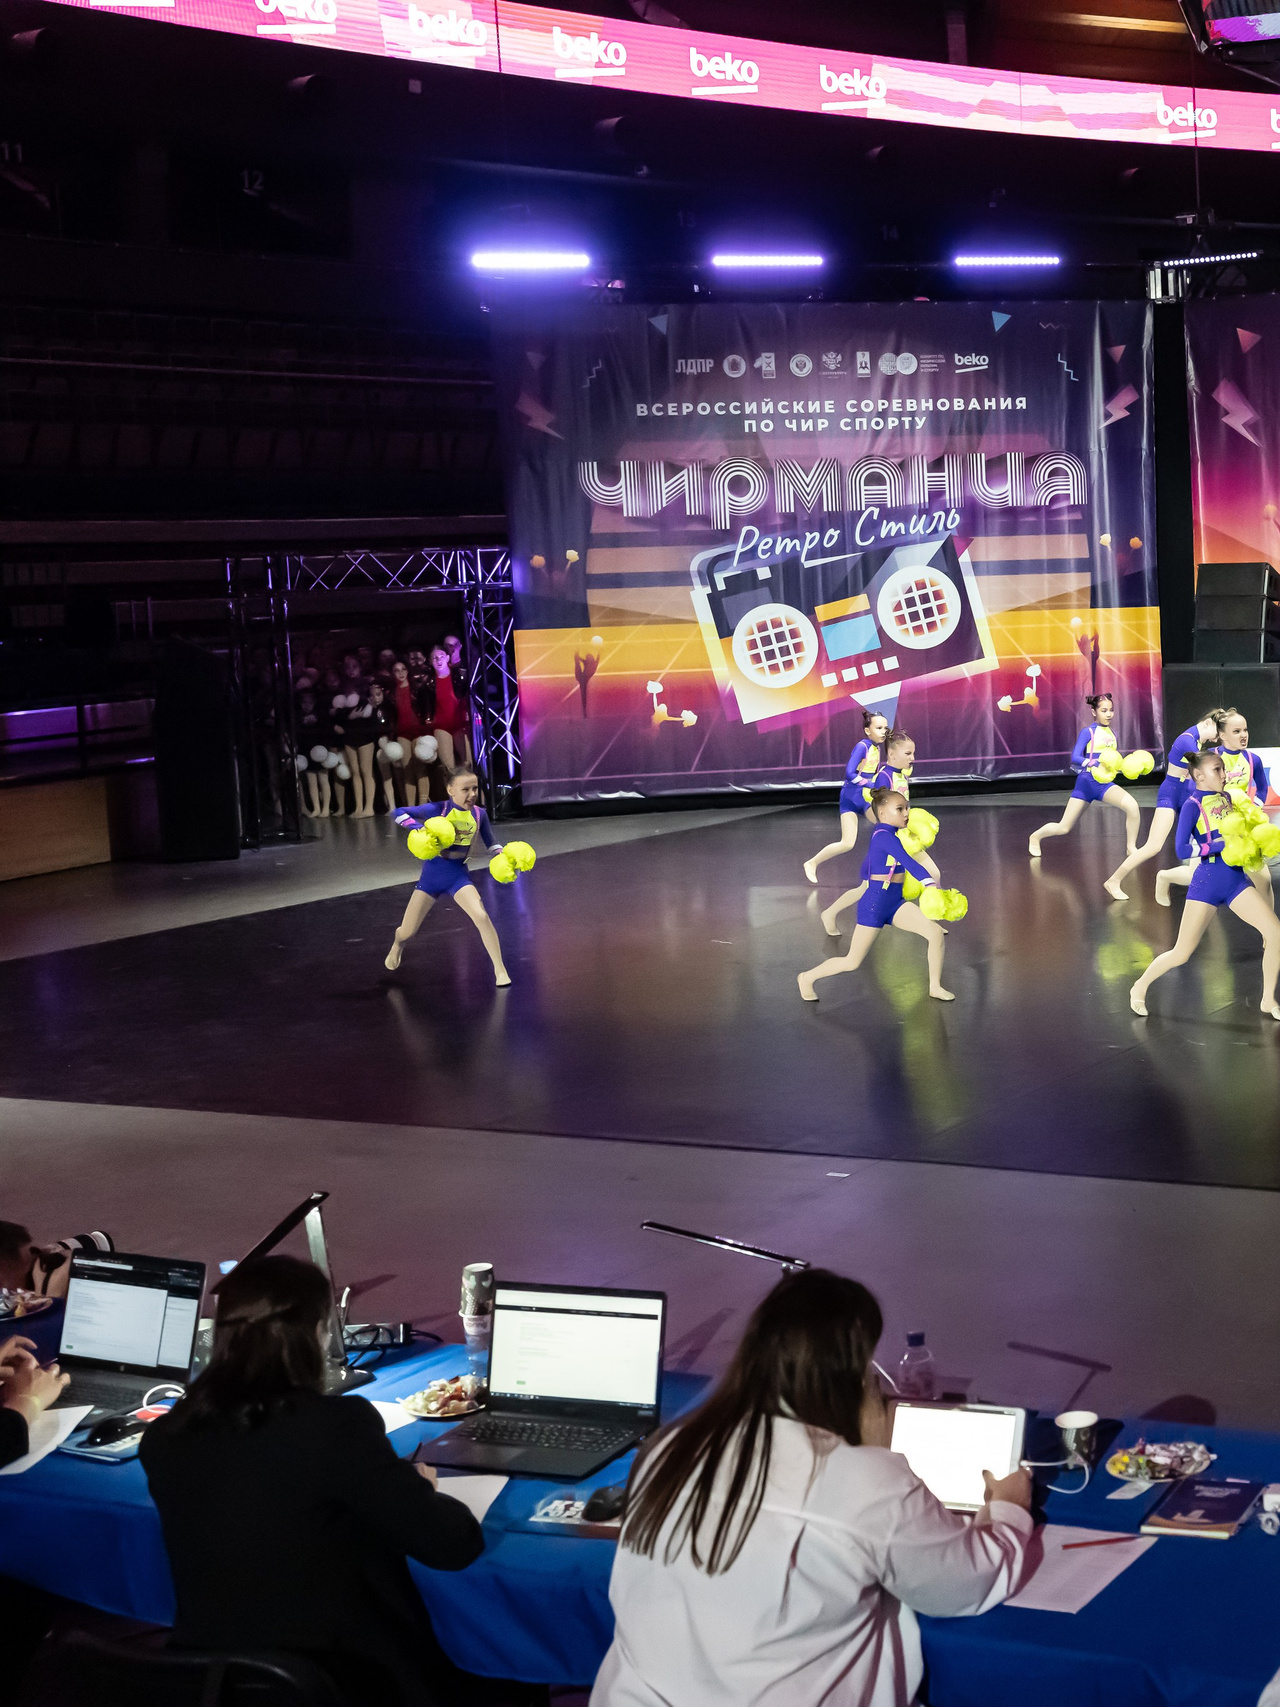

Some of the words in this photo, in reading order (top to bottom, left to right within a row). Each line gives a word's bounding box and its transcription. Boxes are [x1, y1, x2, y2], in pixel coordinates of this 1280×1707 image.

[409, 1, 487, 46] beko
[552, 26, 627, 68] beko
[688, 47, 760, 84] beko
[819, 64, 887, 100] beko
[1157, 98, 1218, 130] beko
[675, 358, 714, 375] ЛДПР
[954, 353, 989, 366] beko
[636, 399, 835, 416] ВСЕРОССИЙСКИЕ
[845, 397, 1028, 414] СОРЕВНОВАНИЯ
[744, 418, 780, 433] ПО
[784, 417, 830, 432] ЧИР
[839, 416, 927, 431] СПОРТУ
[732, 525, 842, 567] Ретро
[855, 506, 961, 546] Стиль
